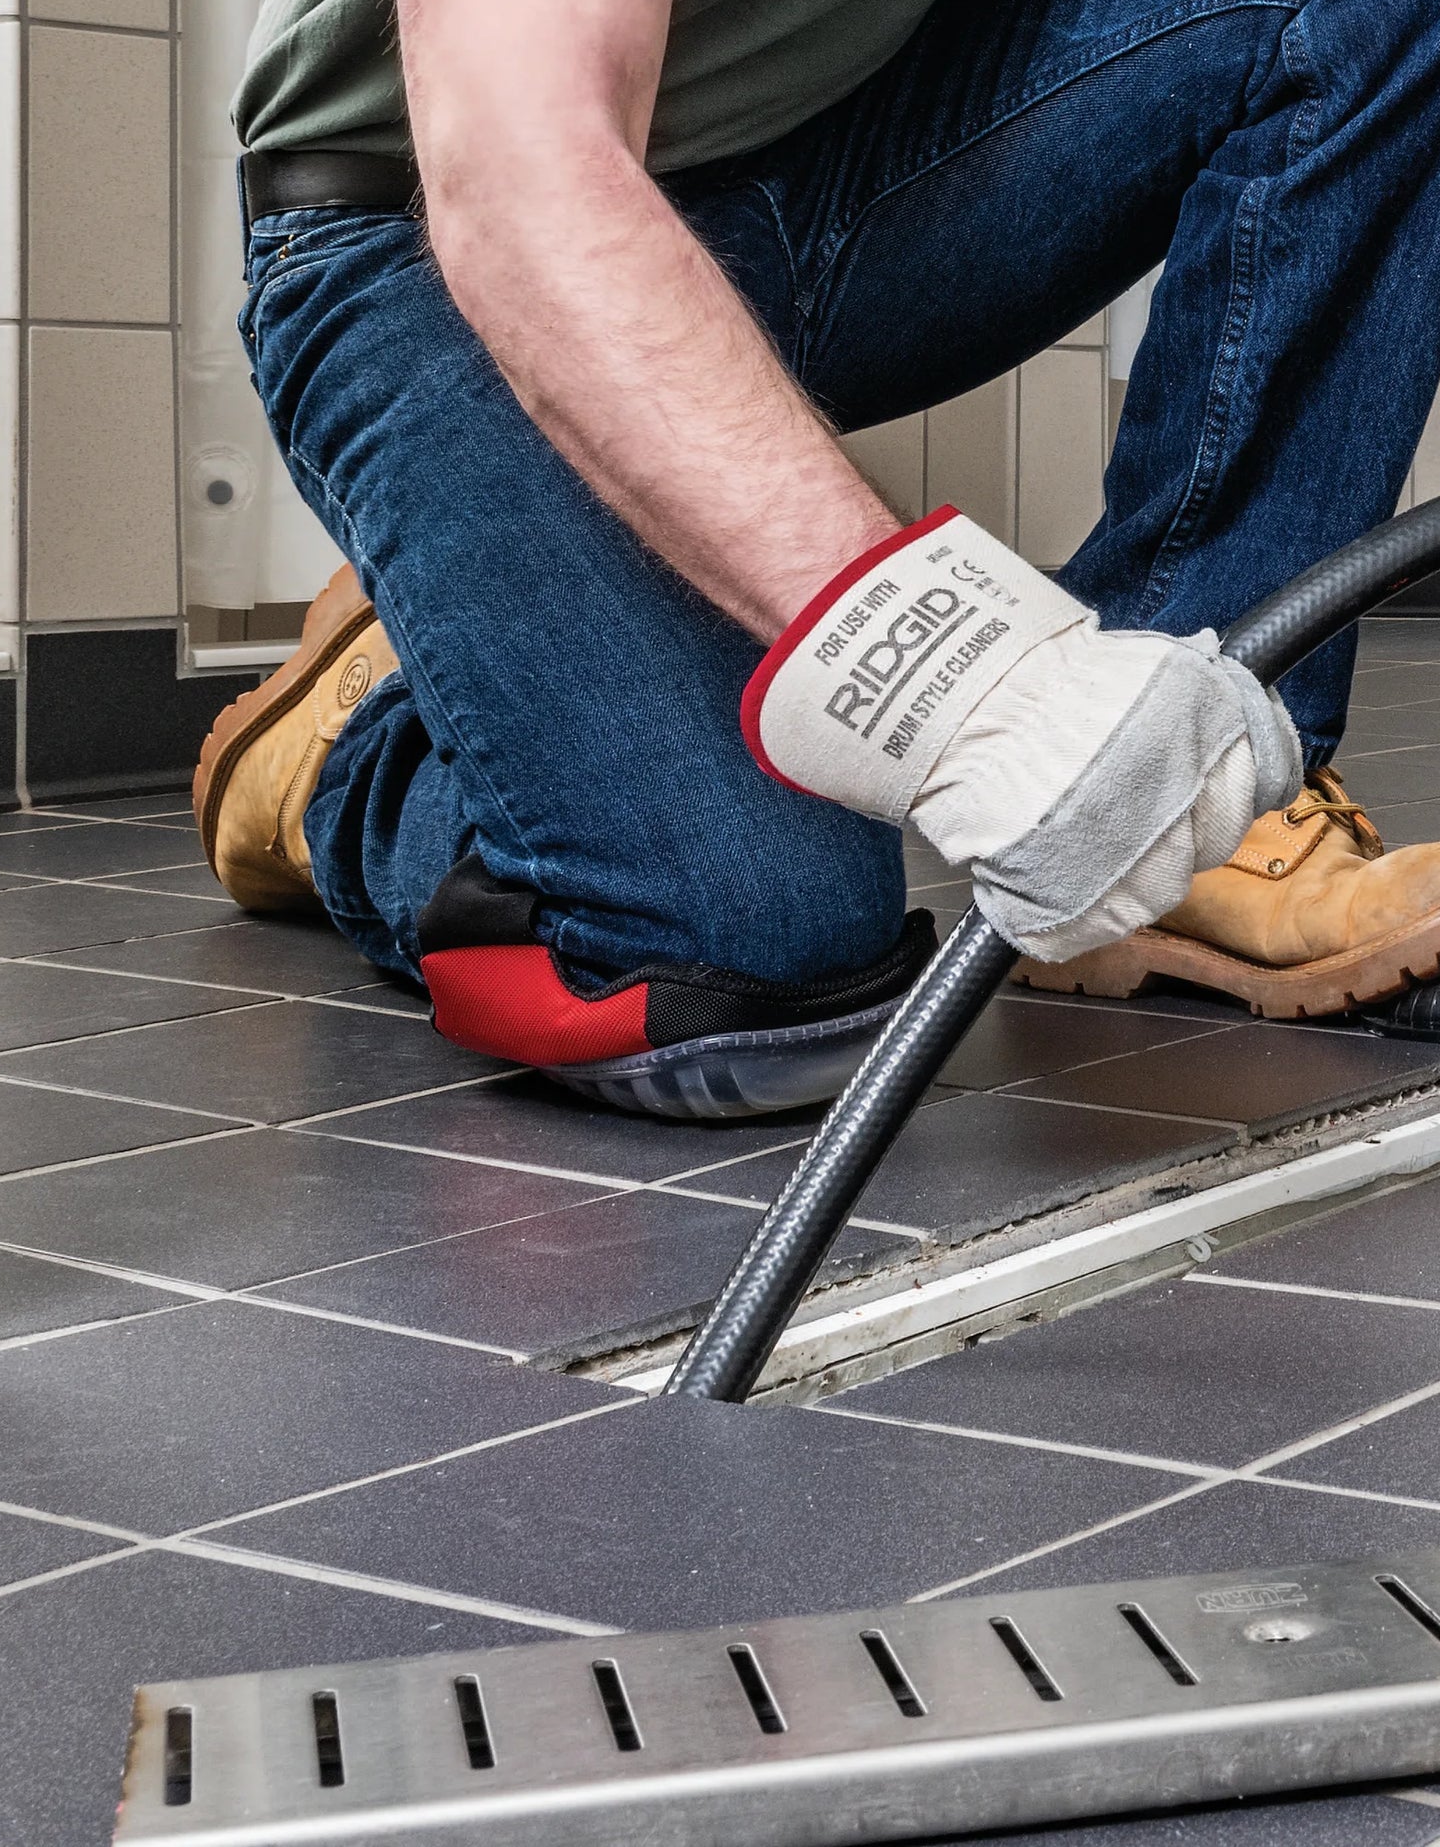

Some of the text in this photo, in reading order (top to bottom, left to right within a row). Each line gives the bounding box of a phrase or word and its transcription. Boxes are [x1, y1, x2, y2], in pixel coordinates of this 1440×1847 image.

[814, 579, 902, 666] FOR USE WITH
[823, 587, 960, 731] RIDGID
[882, 713, 924, 760] DRUM
[910, 670, 957, 719] STYLE
[946, 617, 1011, 677] CLEANERS
[1196, 1583, 1308, 1613] ZURN
